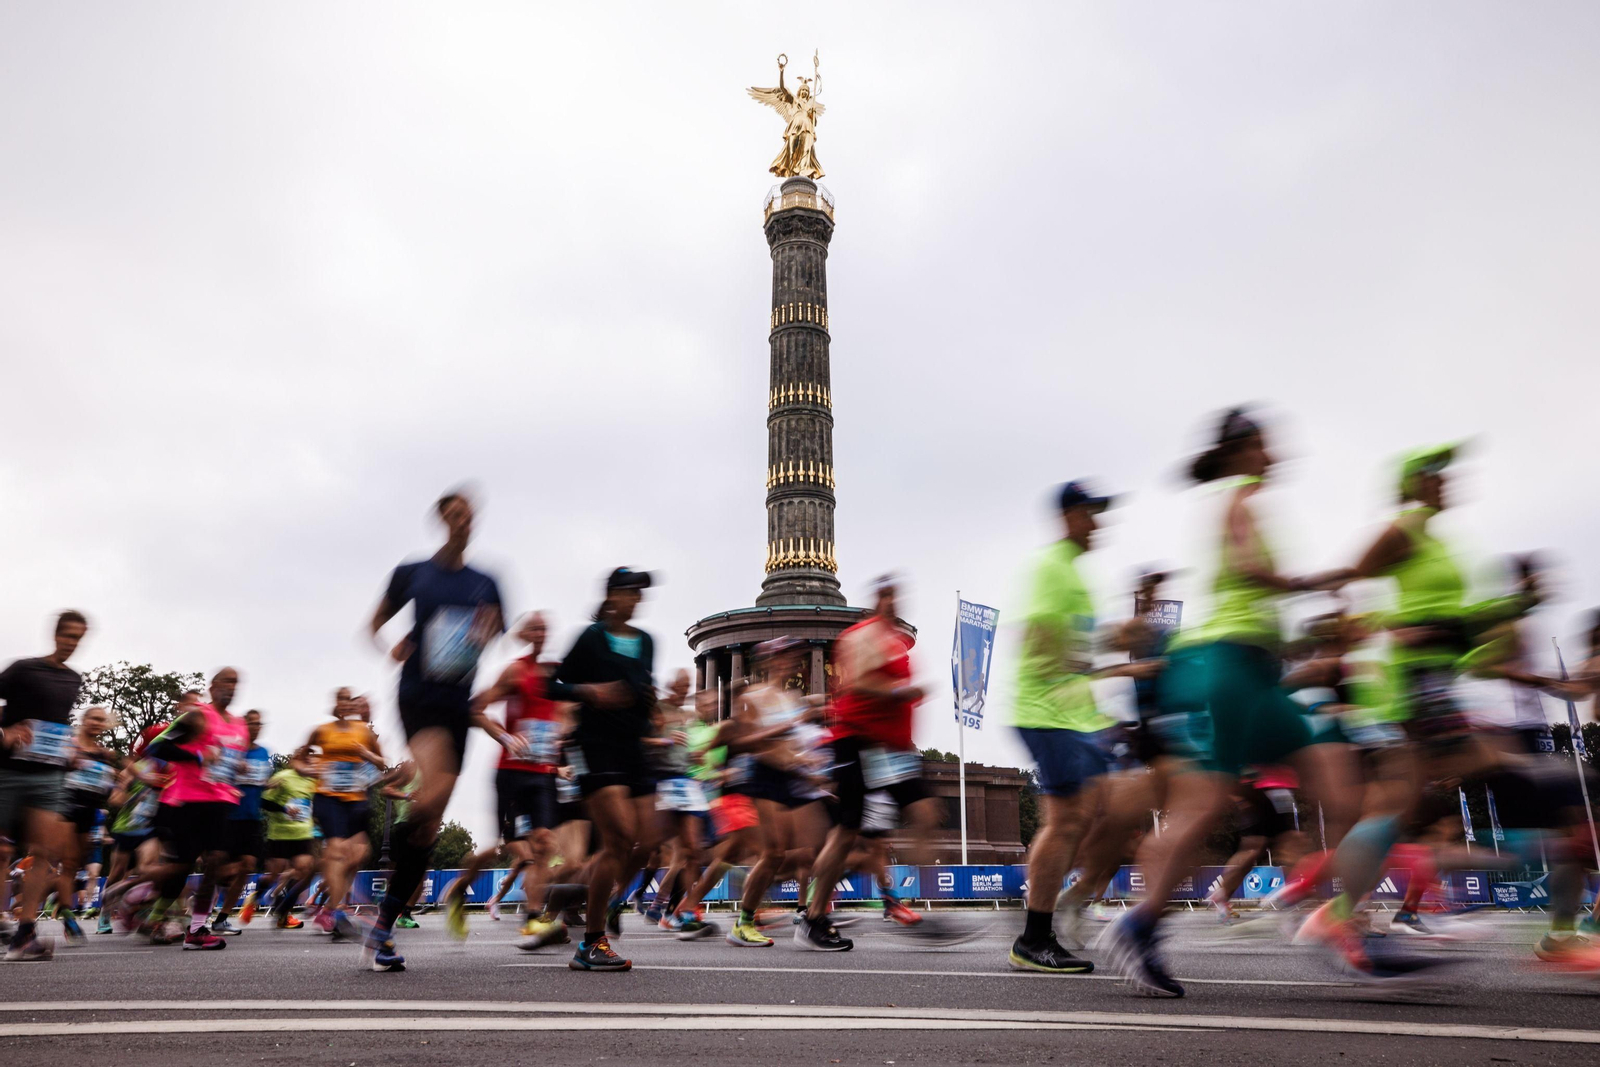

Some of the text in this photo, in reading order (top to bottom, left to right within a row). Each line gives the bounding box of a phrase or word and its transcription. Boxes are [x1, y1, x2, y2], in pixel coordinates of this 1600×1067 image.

[961, 602, 983, 615] BMW
[960, 610, 982, 621] BERLIN
[1141, 617, 1177, 625] ARATHON
[960, 616, 992, 631] MARATHON
[963, 715, 980, 730] 195
[972, 874, 992, 882] BMW
